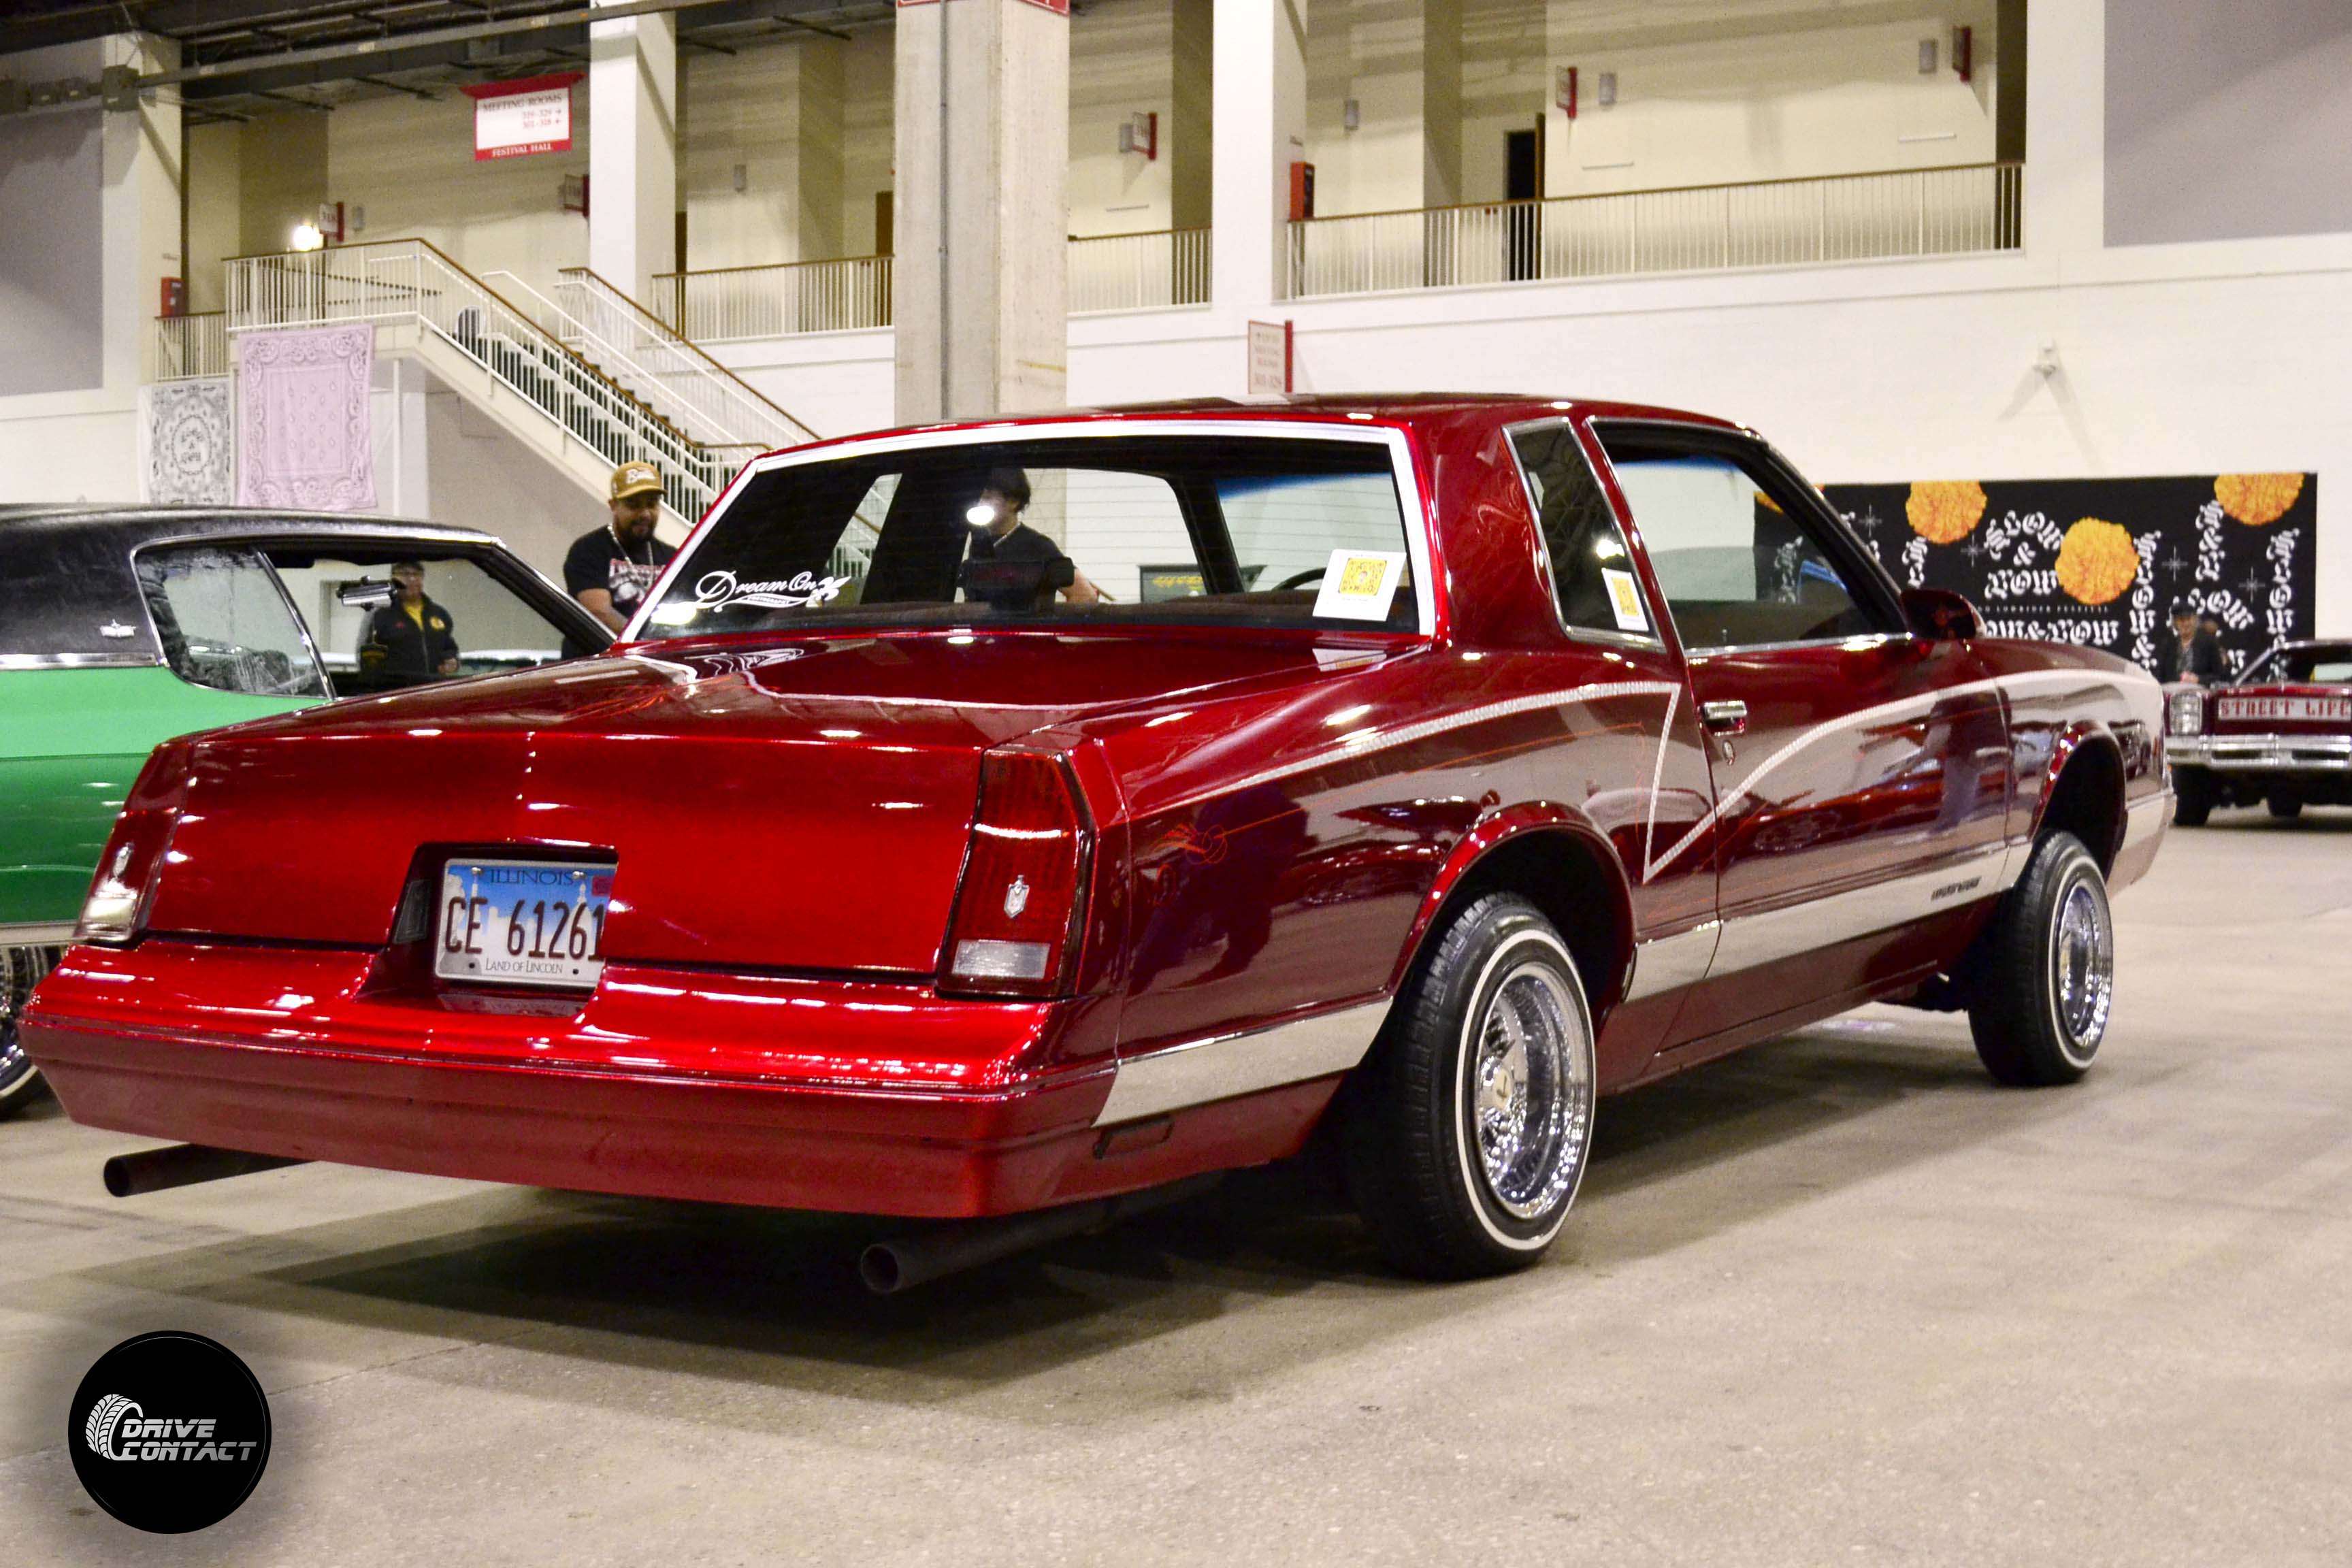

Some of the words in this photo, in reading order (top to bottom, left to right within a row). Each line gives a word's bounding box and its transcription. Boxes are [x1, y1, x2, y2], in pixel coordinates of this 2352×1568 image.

[483, 99, 524, 112] MEETING
[528, 94, 562, 105] ROOMS
[492, 145, 527, 157] FESTIVAL
[531, 142, 551, 152] HALL
[696, 570, 787, 608] Dream
[788, 571, 817, 591] On
[2221, 701, 2294, 716] STREET
[2305, 701, 2349, 716] LIFE
[489, 869, 574, 885] ILLINOIS
[444, 896, 488, 954] CE
[506, 899, 606, 962] 61261
